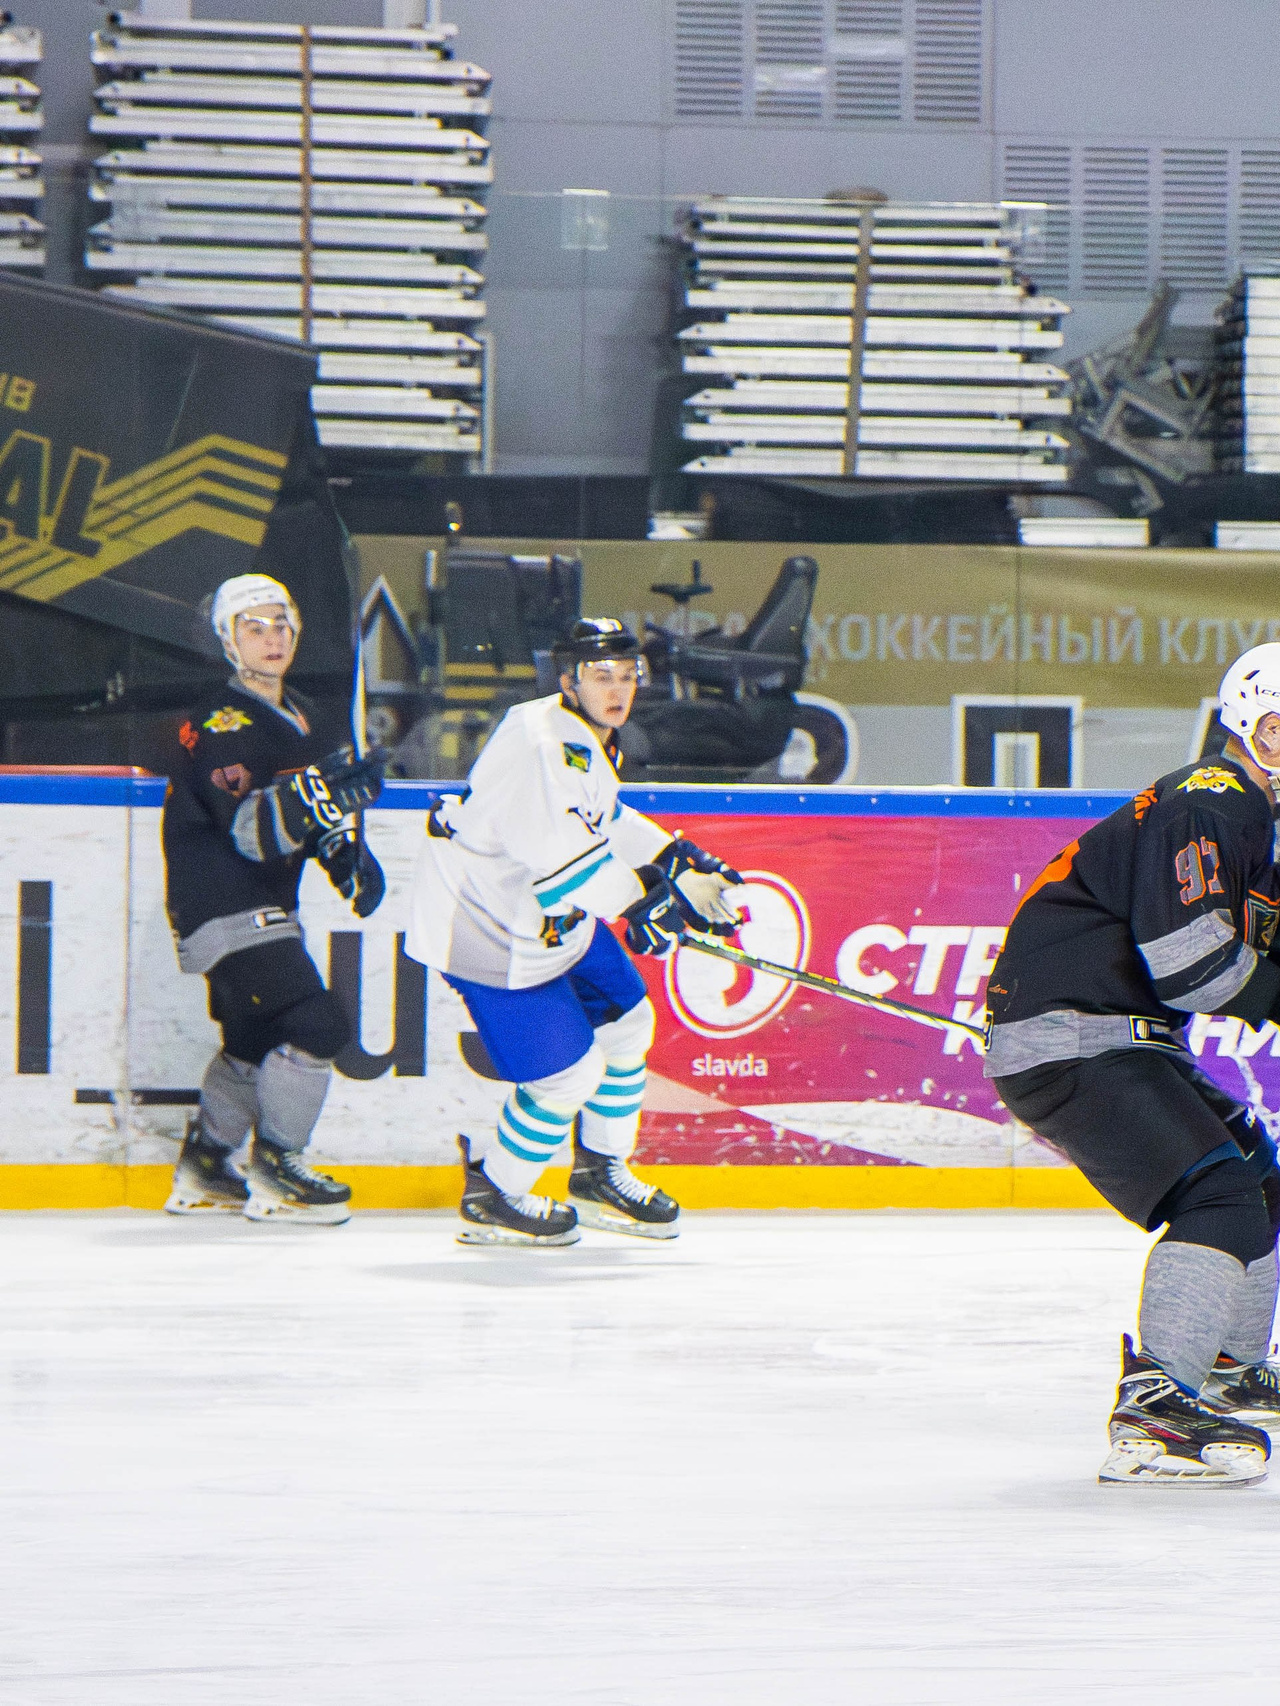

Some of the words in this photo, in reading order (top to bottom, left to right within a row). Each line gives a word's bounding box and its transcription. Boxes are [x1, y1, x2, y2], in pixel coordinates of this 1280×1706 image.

[804, 605, 1145, 665] ХОККЕЙНЫЙ
[1175, 835, 1225, 906] 97
[836, 923, 1009, 995] СТР
[692, 1053, 768, 1077] slavda
